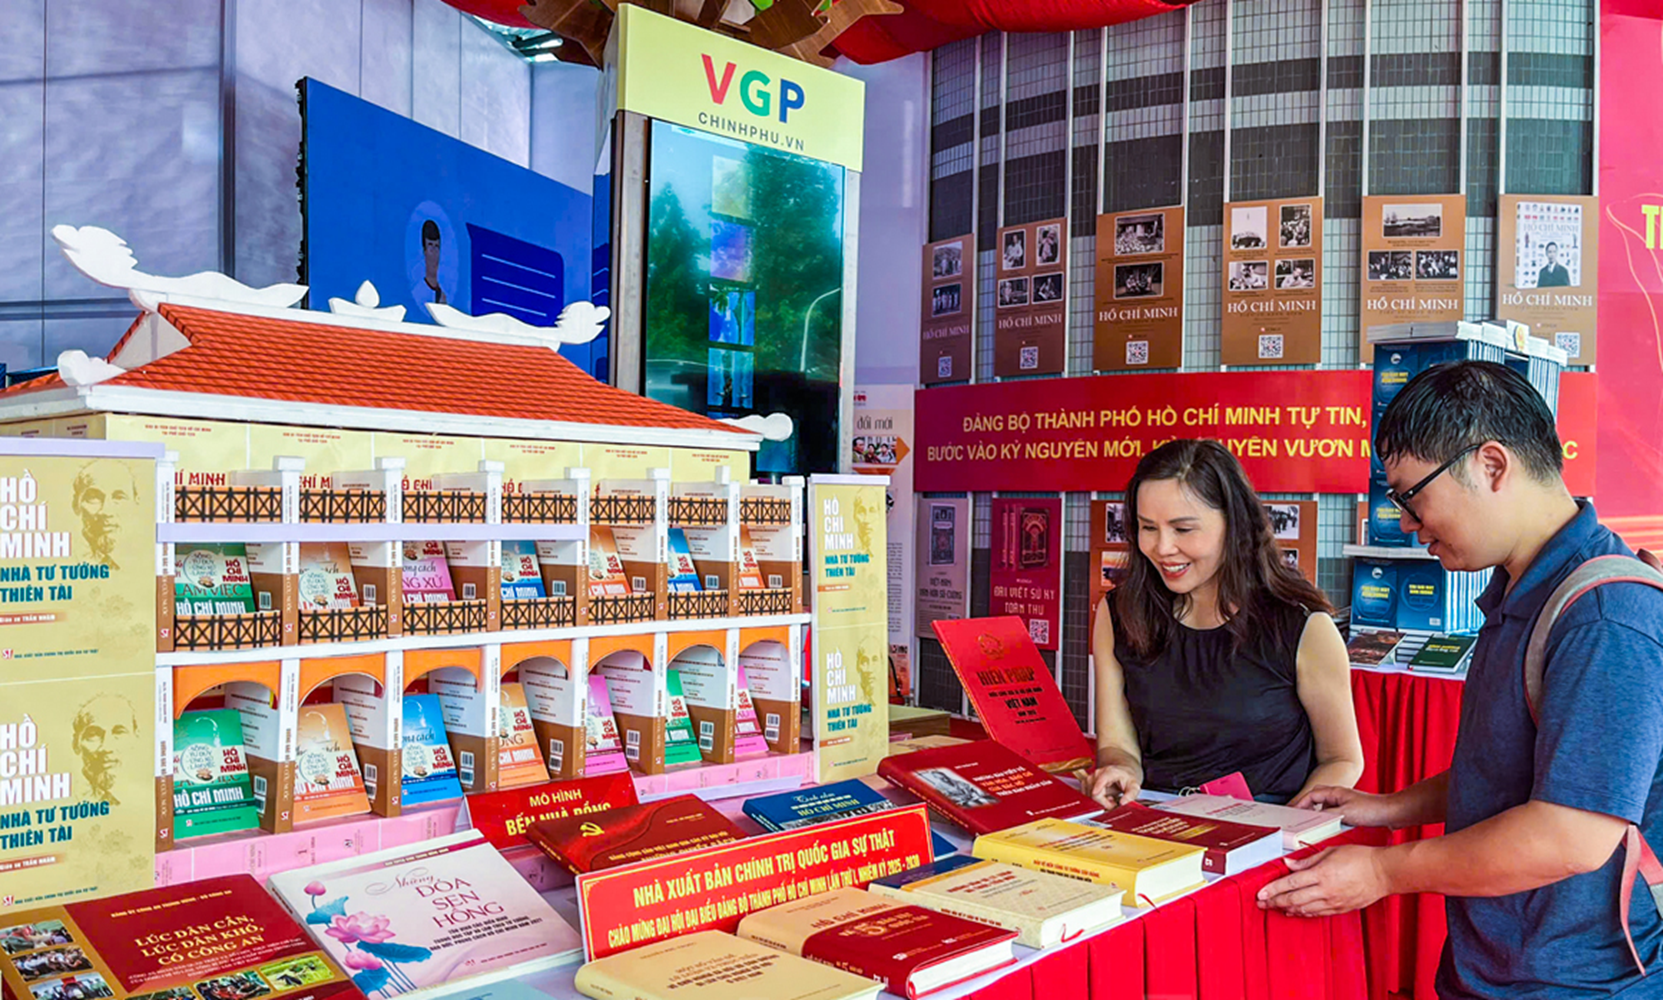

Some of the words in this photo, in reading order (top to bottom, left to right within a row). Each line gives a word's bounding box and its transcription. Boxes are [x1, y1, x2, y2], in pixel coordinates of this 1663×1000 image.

[701, 53, 805, 124] VGP
[698, 111, 805, 151] CHINHPHU.VN
[1227, 299, 1247, 313] HỒ
[1250, 300, 1275, 313] CHÍ
[1278, 299, 1316, 312] MINH
[1367, 295, 1389, 310] HỒ
[1390, 296, 1416, 310] CHÍ
[1420, 298, 1459, 310] MINH
[1503, 291, 1524, 306] HỒ
[1526, 291, 1551, 307] CHÍ
[1554, 295, 1593, 307] MINH
[1035, 313, 1062, 326] MINH
[1099, 307, 1118, 322] HỒ
[1119, 307, 1141, 321] CHÍ
[1144, 306, 1178, 320] MINH
[963, 412, 1004, 433] ĐẢNG
[1007, 411, 1030, 434] BỘ
[1034, 408, 1095, 429] THÀNH
[1099, 405, 1142, 427] PHỐ
[1146, 404, 1178, 426] HỒ
[1183, 402, 1219, 425] CHÍ
[1225, 407, 1280, 425] MINH
[1286, 407, 1321, 430] TỰ
[1325, 406, 1368, 428] TIN,
[927, 442, 964, 462] BƯỚC
[966, 441, 998, 461] VÀO
[1024, 437, 1099, 459] NGUYÊN
[1103, 436, 1146, 458] MỚI,
[1284, 438, 1354, 457] VƯƠN
[0, 468, 38, 504] HỒ
[188, 472, 226, 486] MINH
[0, 501, 48, 532] CHÍ
[823, 495, 839, 516] HỒ
[0, 532, 72, 559] MINH
[824, 533, 854, 550] MINH
[0, 564, 31, 582] NHÀ
[35, 564, 57, 581] TƯ
[60, 562, 110, 580] TƯỞNG
[0, 584, 44, 603] THIÊN
[48, 583, 73, 600] TÀI
[826, 647, 843, 670] HỒ
[826, 665, 847, 687] CHÍ
[826, 684, 857, 705] MINH
[0, 713, 38, 750] HỒ
[0, 743, 48, 779] CHÍ
[0, 772, 72, 807] MINH
[174, 788, 190, 808] HỒ
[191, 787, 212, 806] CHÍ
[212, 786, 244, 801] MINH
[529, 792, 551, 807] MÔ
[551, 788, 583, 803] HÌNH
[0, 809, 31, 830] NHÀ
[35, 805, 57, 825] TƯ
[60, 801, 110, 821] TƯỞNG
[0, 828, 44, 850] THIÊN
[48, 824, 73, 844] TÀI
[633, 879, 665, 908] NHÀ
[666, 868, 702, 900] XUẤT
[704, 863, 733, 891] BẢN
[735, 857, 774, 883] CHÍNH
[776, 852, 795, 874] TRỊ
[797, 840, 829, 870] QUỐC
[830, 839, 850, 861] GIA
[852, 834, 868, 857] SỰ
[868, 828, 896, 852] THẬT
[431, 889, 481, 911] SEN
[134, 928, 174, 948] LÚC
[174, 919, 211, 940] DÂN
[141, 941, 178, 959] LÚC
[180, 931, 219, 950] DÂN
[608, 923, 631, 948] CHÀO
[158, 950, 185, 966] CÓ
[187, 940, 240, 960] CÔNG
[241, 933, 265, 948] AN
